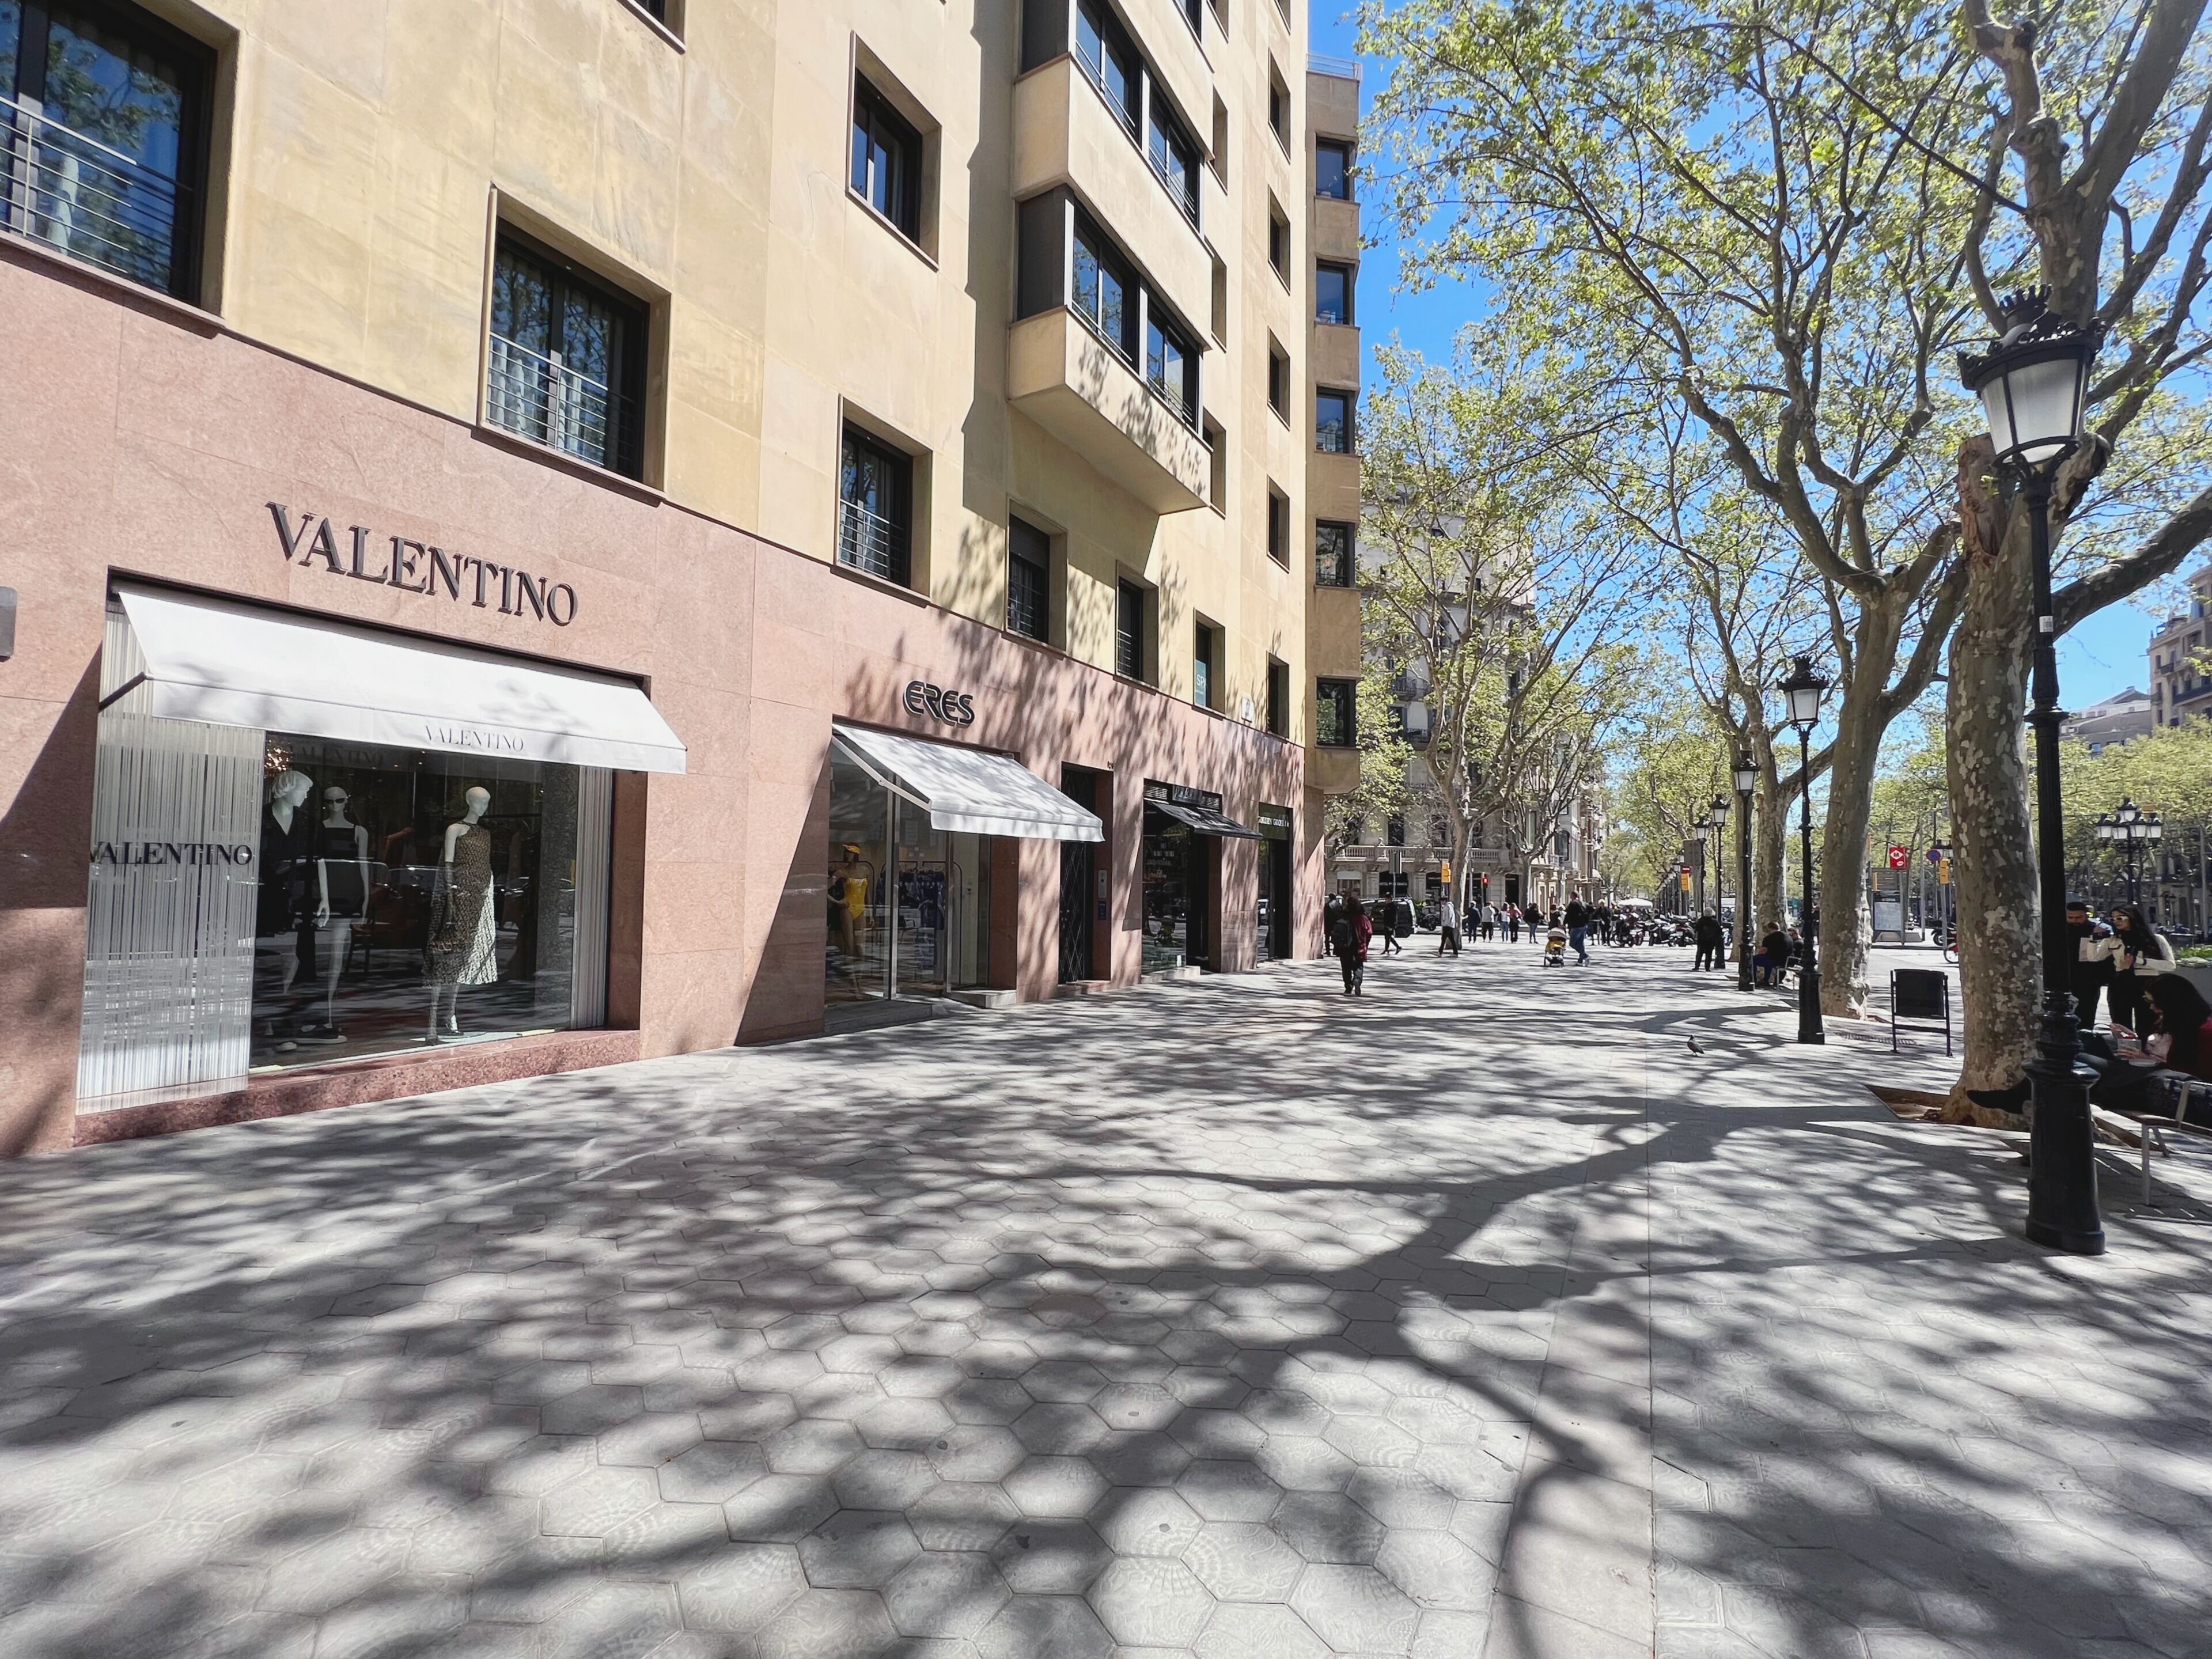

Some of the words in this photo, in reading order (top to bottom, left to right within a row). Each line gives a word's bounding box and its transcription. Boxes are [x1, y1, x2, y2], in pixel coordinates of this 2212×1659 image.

[264, 501, 578, 627] VALENTINO
[904, 680, 975, 726] ERES
[425, 725, 524, 752] VALENTINO
[89, 842, 253, 865] VALENTINO
